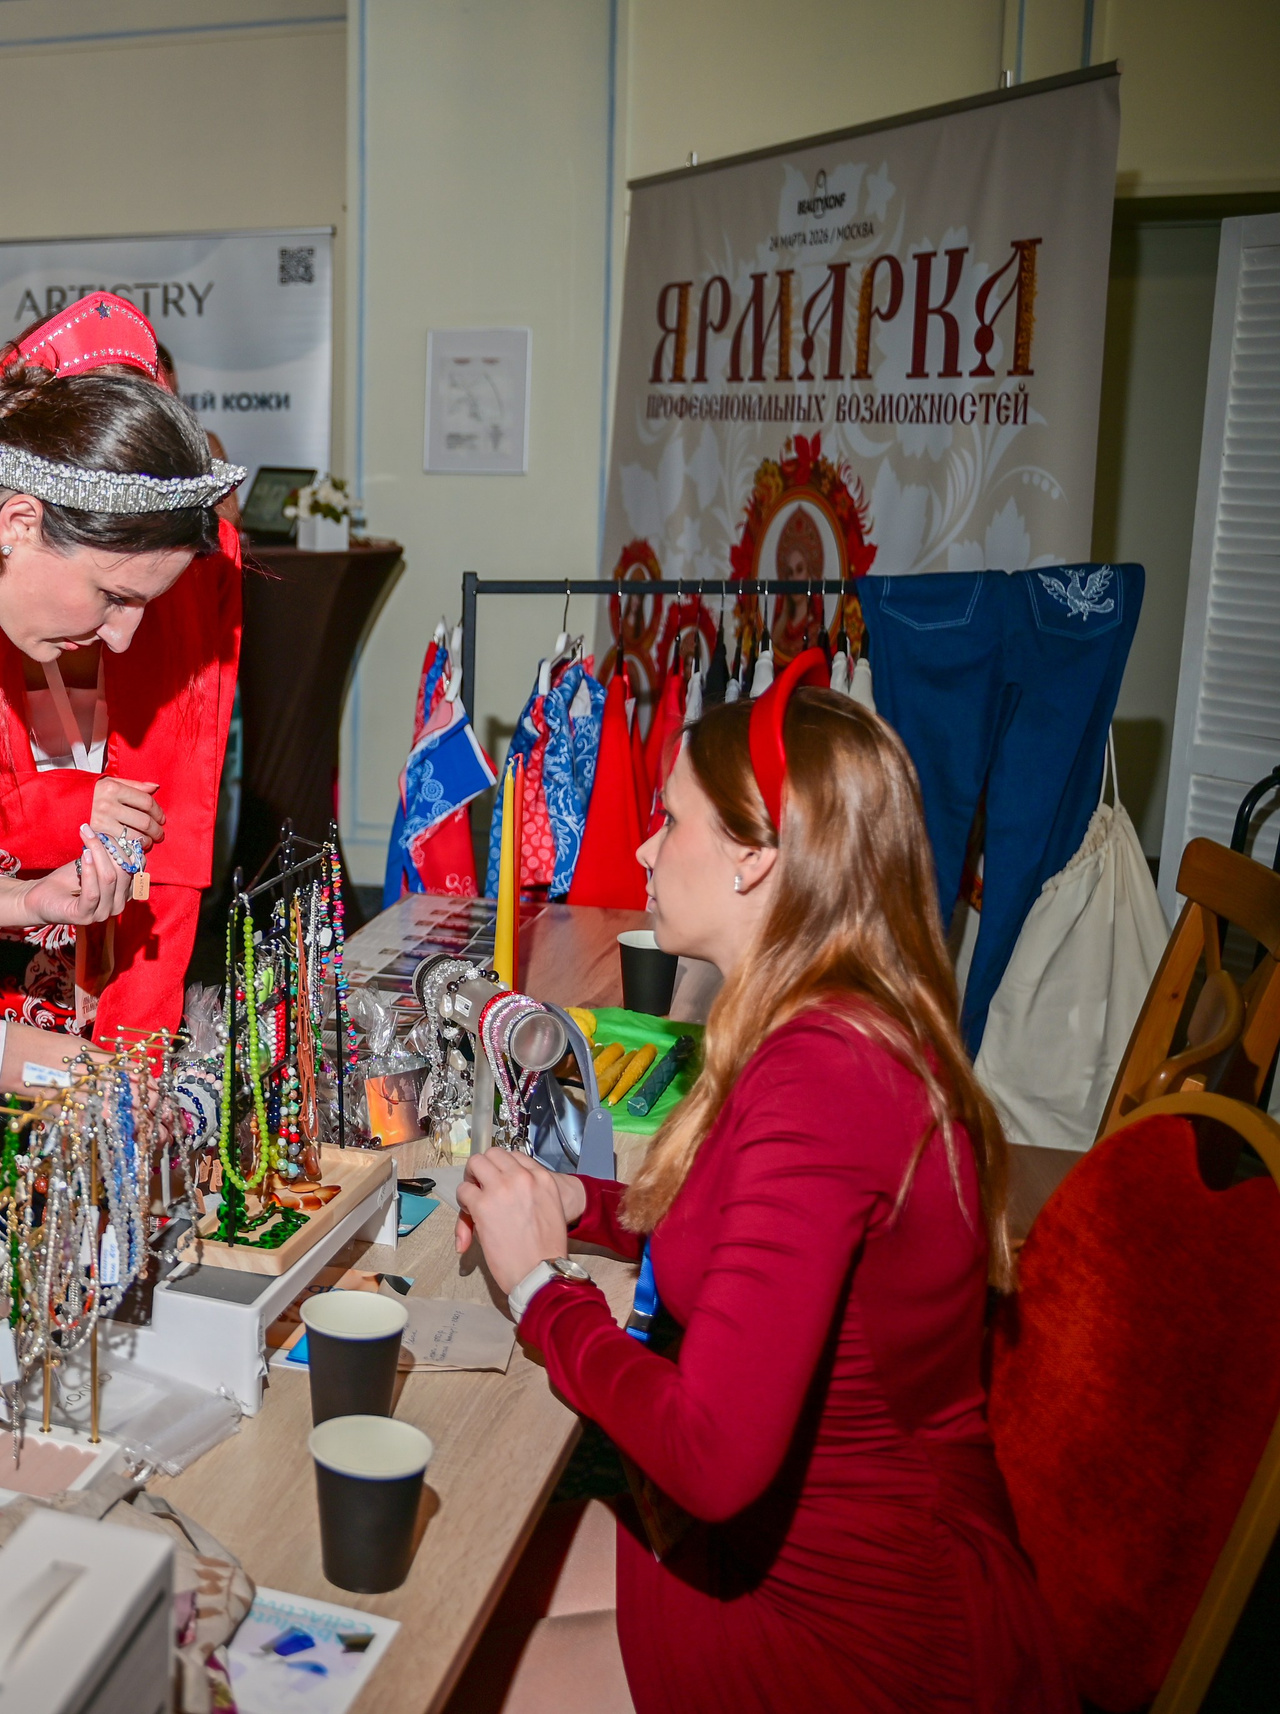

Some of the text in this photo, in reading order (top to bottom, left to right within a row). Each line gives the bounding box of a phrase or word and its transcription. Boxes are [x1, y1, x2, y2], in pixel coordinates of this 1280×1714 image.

[780, 231, 807, 249] МАРТА
[836, 222, 875, 241] МОСКВА
[14, 281, 215, 322] ARTRY
[648, 237, 1043, 384] ЯРМАРКА
[221, 391, 290, 412] КОЖИ
[646, 383, 1030, 425] ПРОФЕССИОНАЛЬНЫХ ВОЗМОЖНОСТЕЙ
